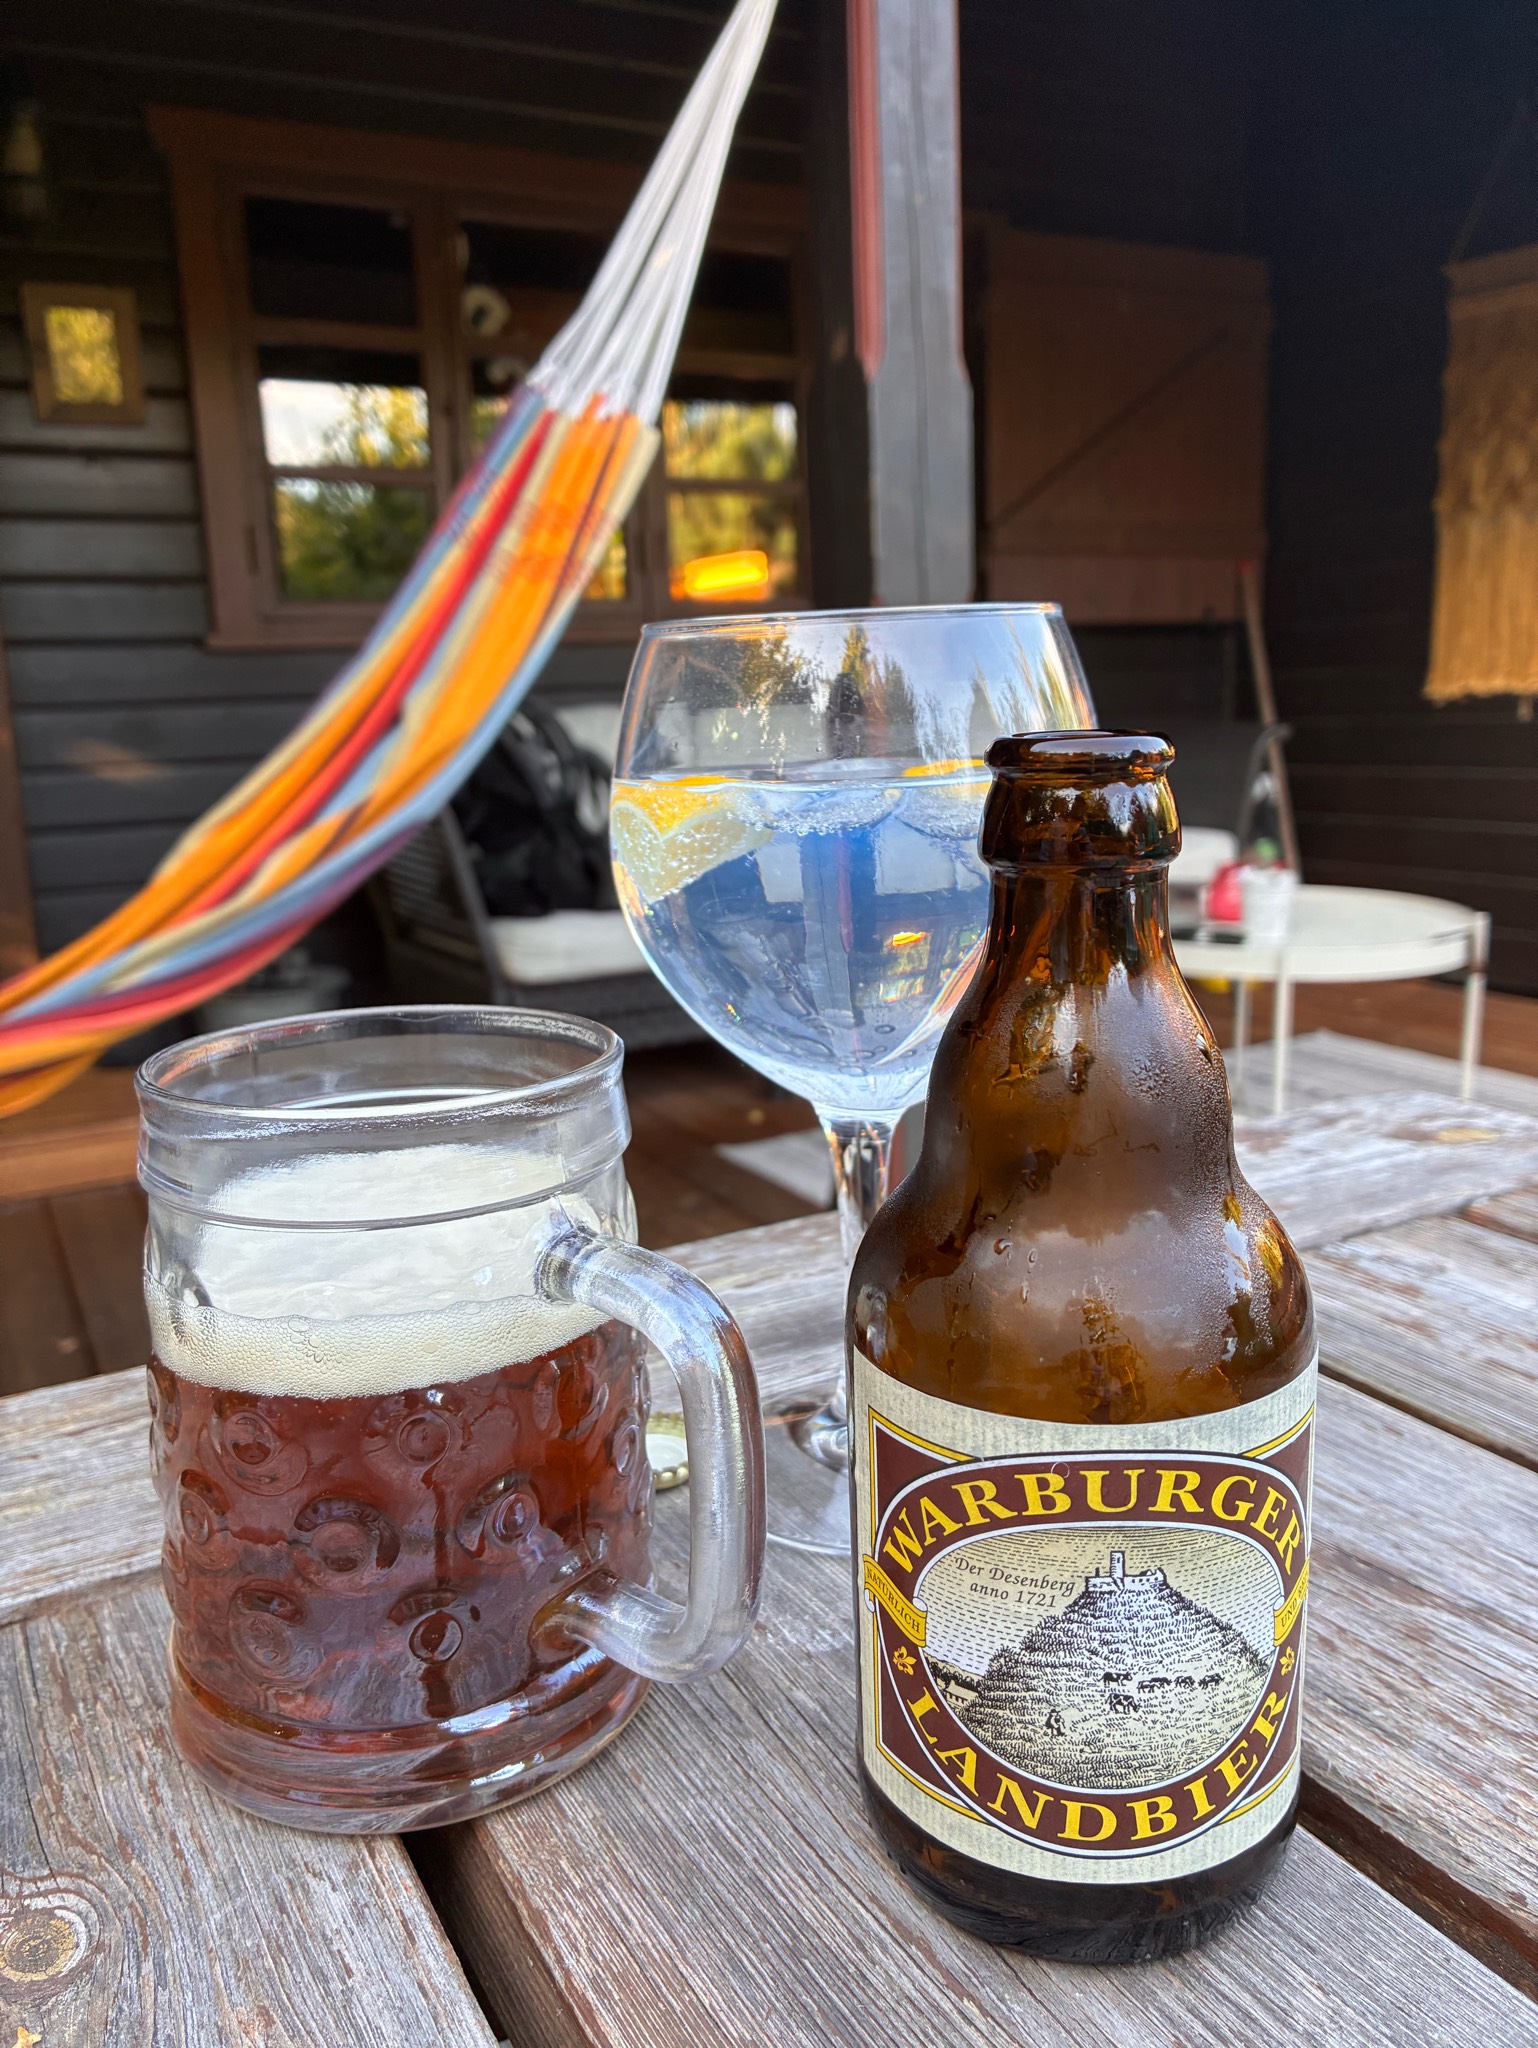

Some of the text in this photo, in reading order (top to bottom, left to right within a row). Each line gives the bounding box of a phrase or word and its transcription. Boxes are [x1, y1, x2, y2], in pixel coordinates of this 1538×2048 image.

[883, 1468, 1301, 1576] WARBURGER
[955, 1557, 1076, 1598] Der Desenberg
[970, 1582, 1057, 1608] anno 1721
[906, 1687, 1289, 1842] LANDBIER
